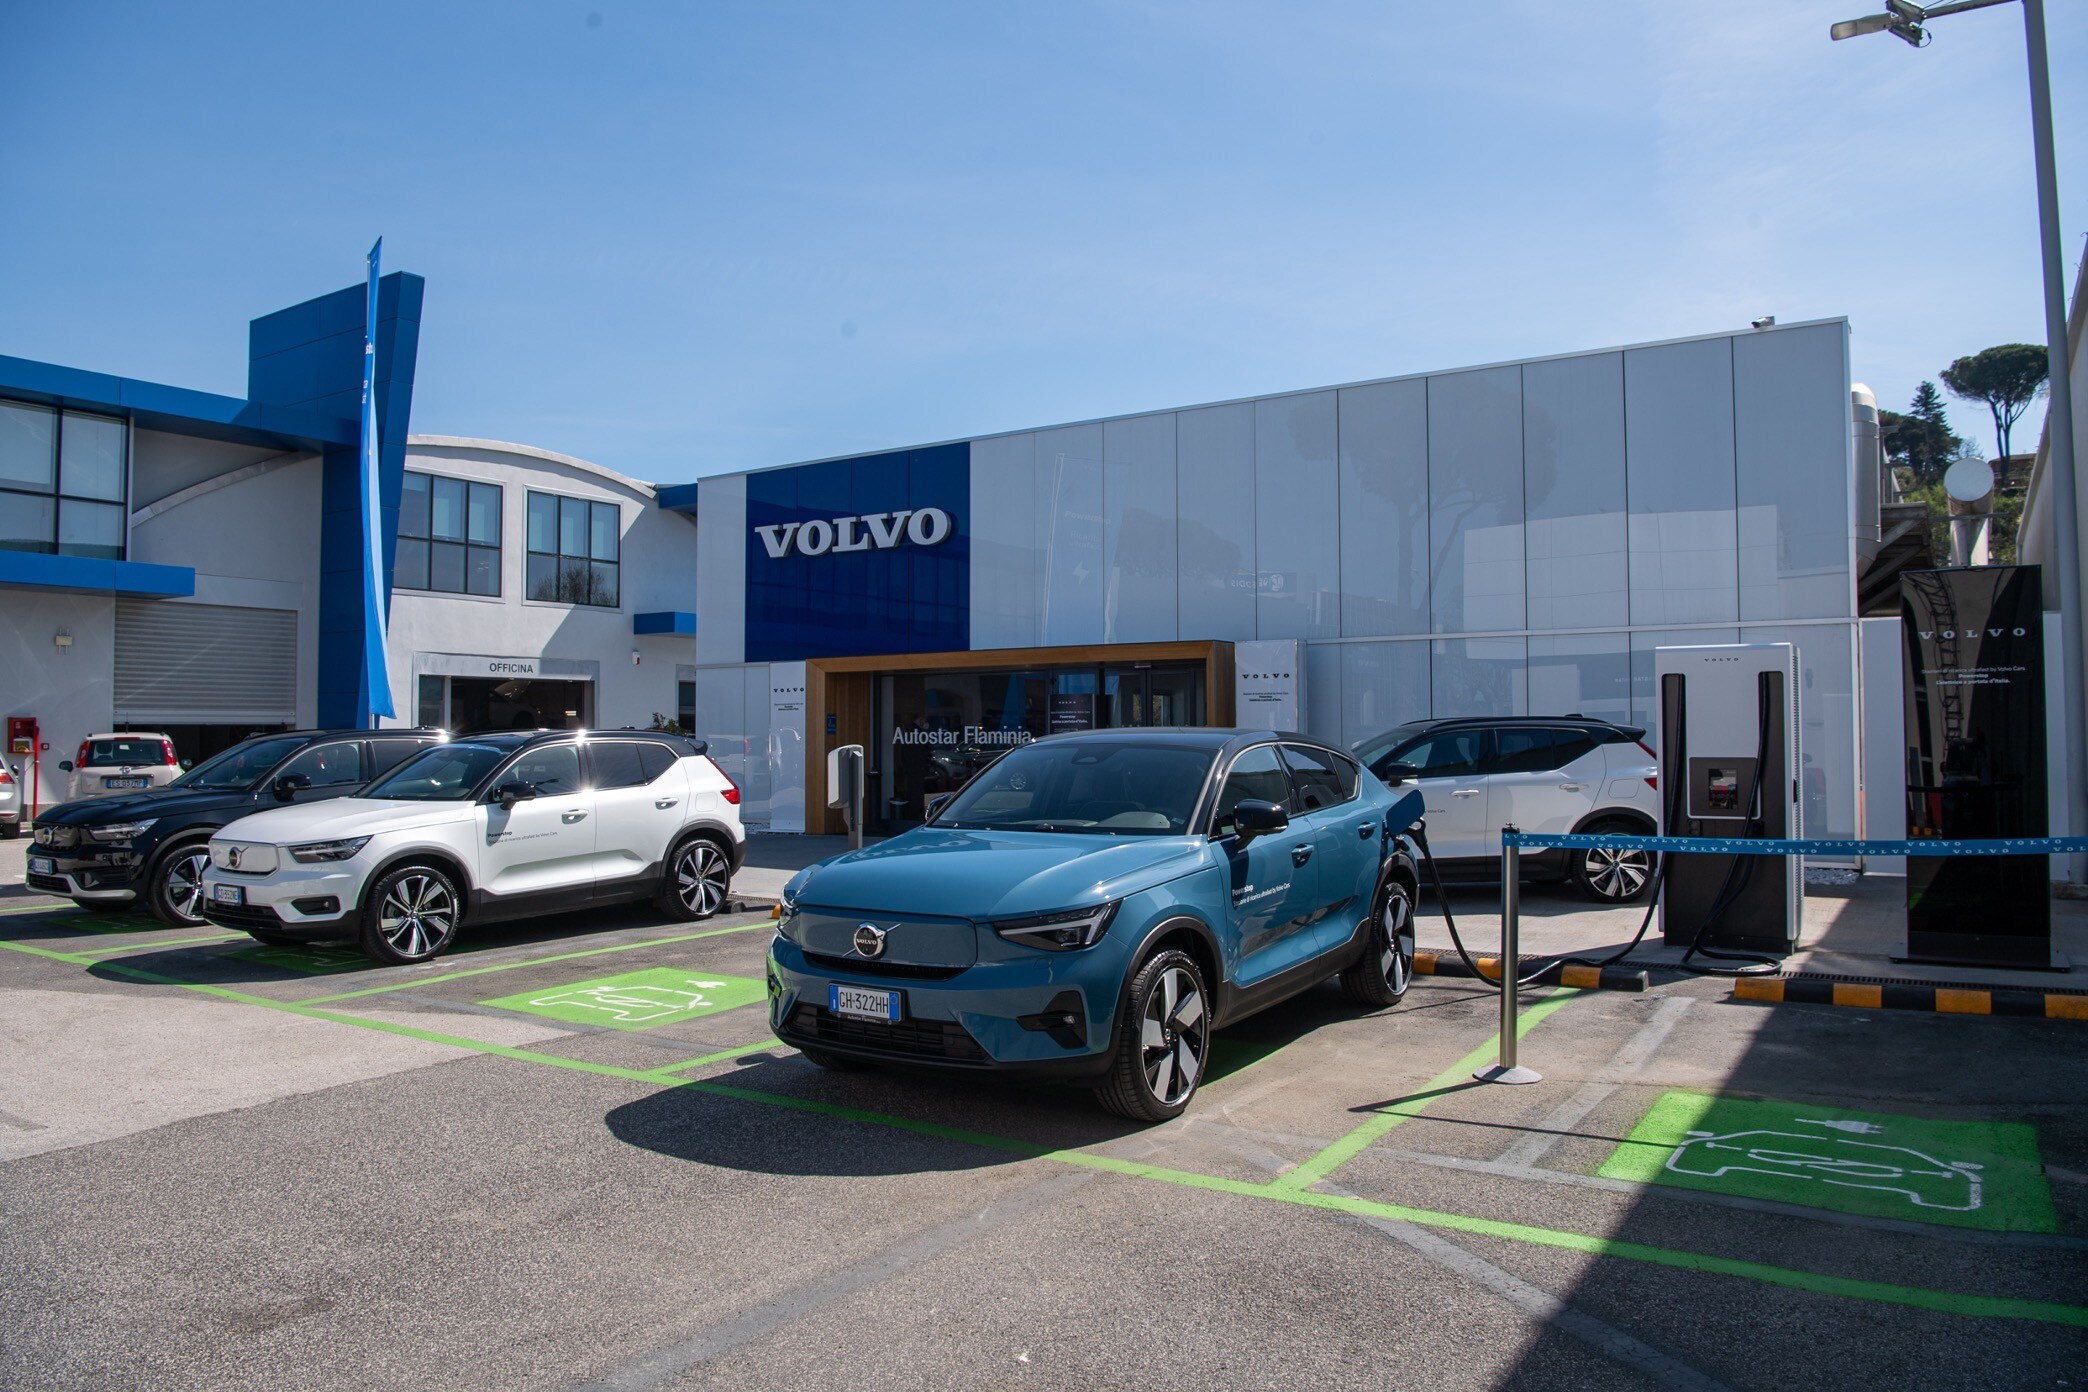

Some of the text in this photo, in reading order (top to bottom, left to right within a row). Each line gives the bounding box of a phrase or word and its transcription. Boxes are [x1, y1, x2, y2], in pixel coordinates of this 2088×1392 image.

[754, 507, 951, 558] VOLVO
[1919, 627, 2026, 640] VOLVO
[489, 662, 534, 674] OFFICINA
[892, 725, 1032, 745] Autostar Flaminia
[856, 938, 877, 946] VOLVO
